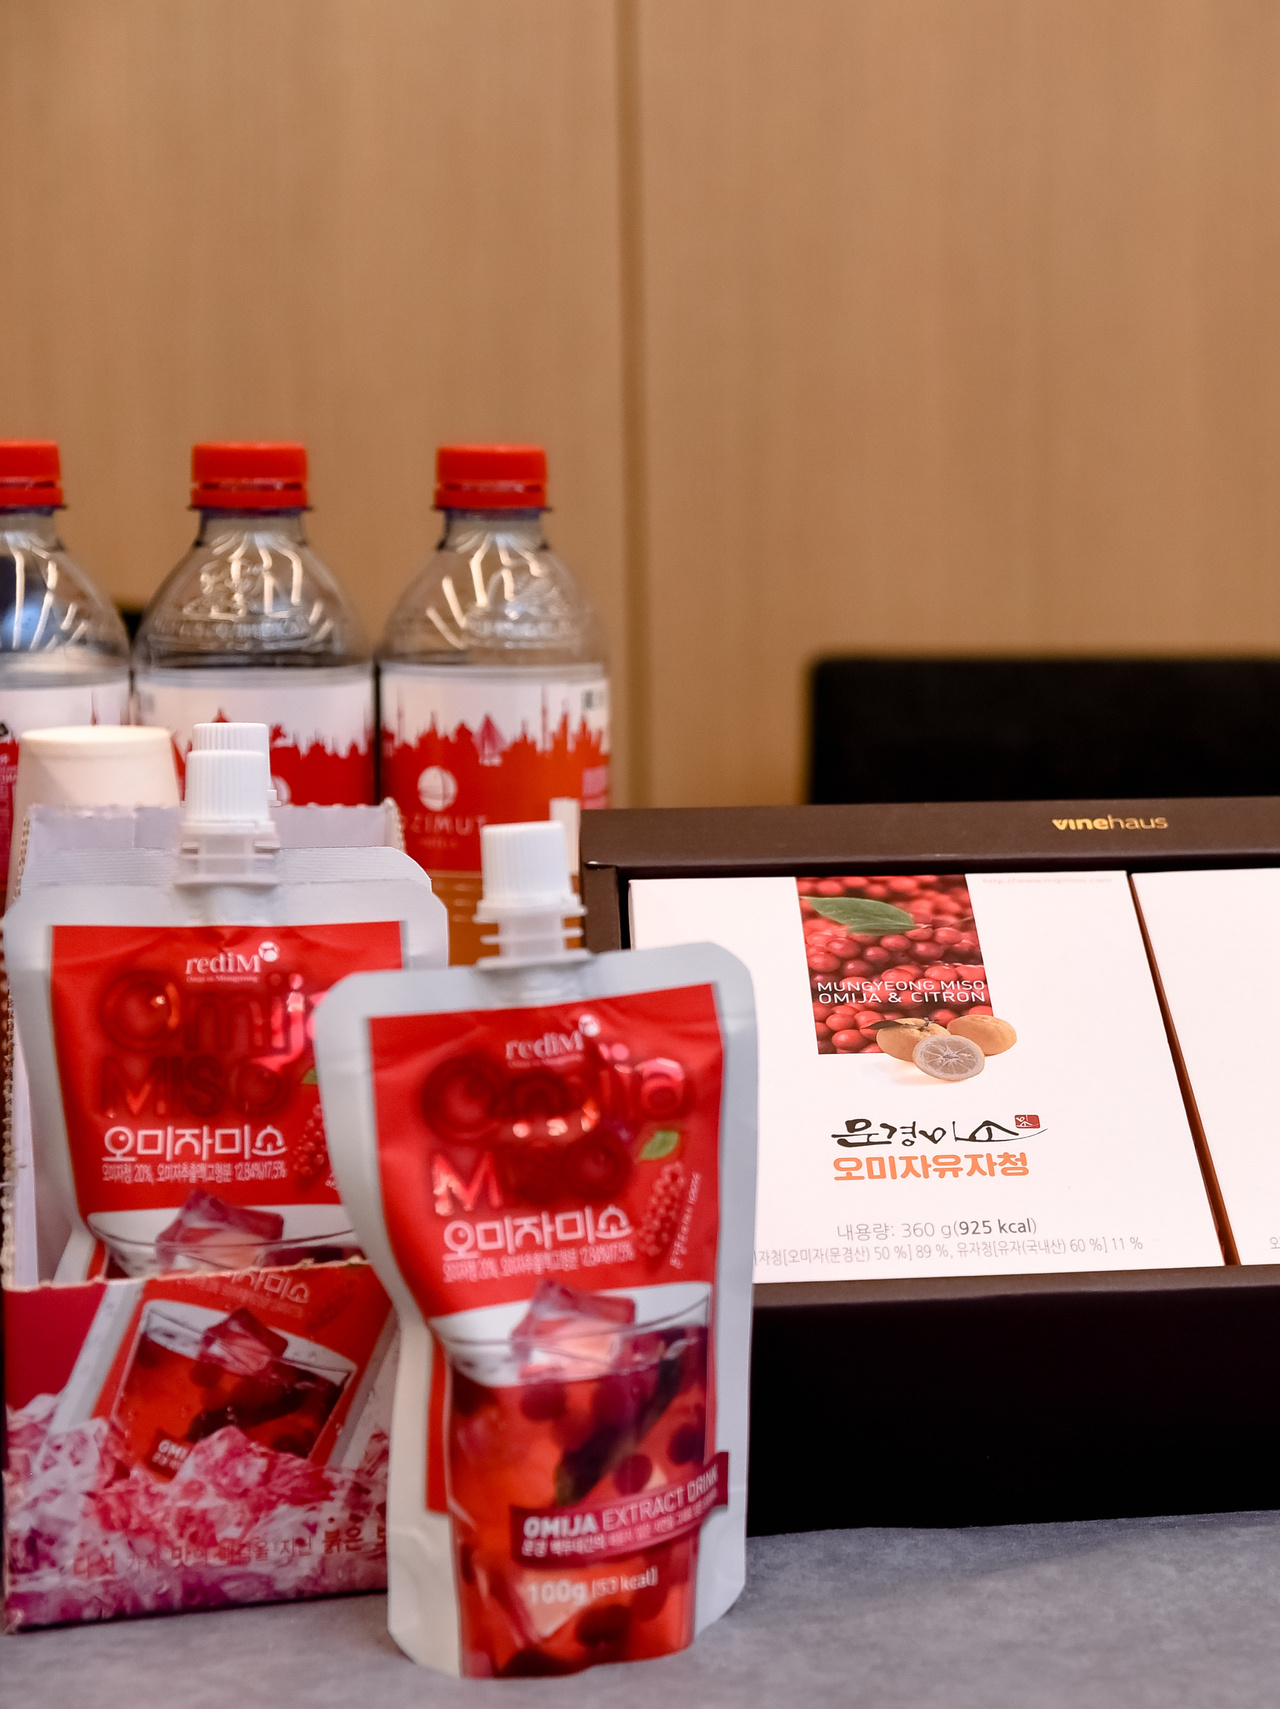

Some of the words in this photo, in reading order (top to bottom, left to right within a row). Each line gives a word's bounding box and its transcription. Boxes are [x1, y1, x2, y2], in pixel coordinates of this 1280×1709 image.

[1052, 814, 1169, 831] vinehaus
[185, 952, 261, 974] rediM
[817, 981, 935, 992] MUNGYEONG
[940, 980, 985, 990] MISO
[818, 992, 882, 1004] OMIJA
[888, 992, 902, 1003] &
[911, 991, 986, 1003] CITRON
[102, 1123, 287, 1162] 오미자미소
[831, 1117, 1048, 1148] 문경미소
[833, 1151, 1030, 1181] 오미자유자청
[442, 1203, 634, 1261] 오미자미소
[837, 1222, 895, 1241] 내용량:
[900, 1222, 935, 1238] 360
[941, 1220, 993, 1239] g(925
[997, 1218, 1038, 1235] kcal)
[874, 1246, 892, 1260] 50
[893, 1243, 914, 1261] %]
[916, 1244, 932, 1259] 89
[956, 1237, 1067, 1258] 유자청[유자(국내산)
[1070, 1239, 1087, 1254] 60
[1089, 1237, 1108, 1254] %]
[1112, 1238, 1125, 1252] 11
[1128, 1237, 1144, 1251] %
[523, 1512, 599, 1539] OMIJA
[602, 1489, 685, 1532] EXTRACT
[528, 1579, 588, 1607] 100g
